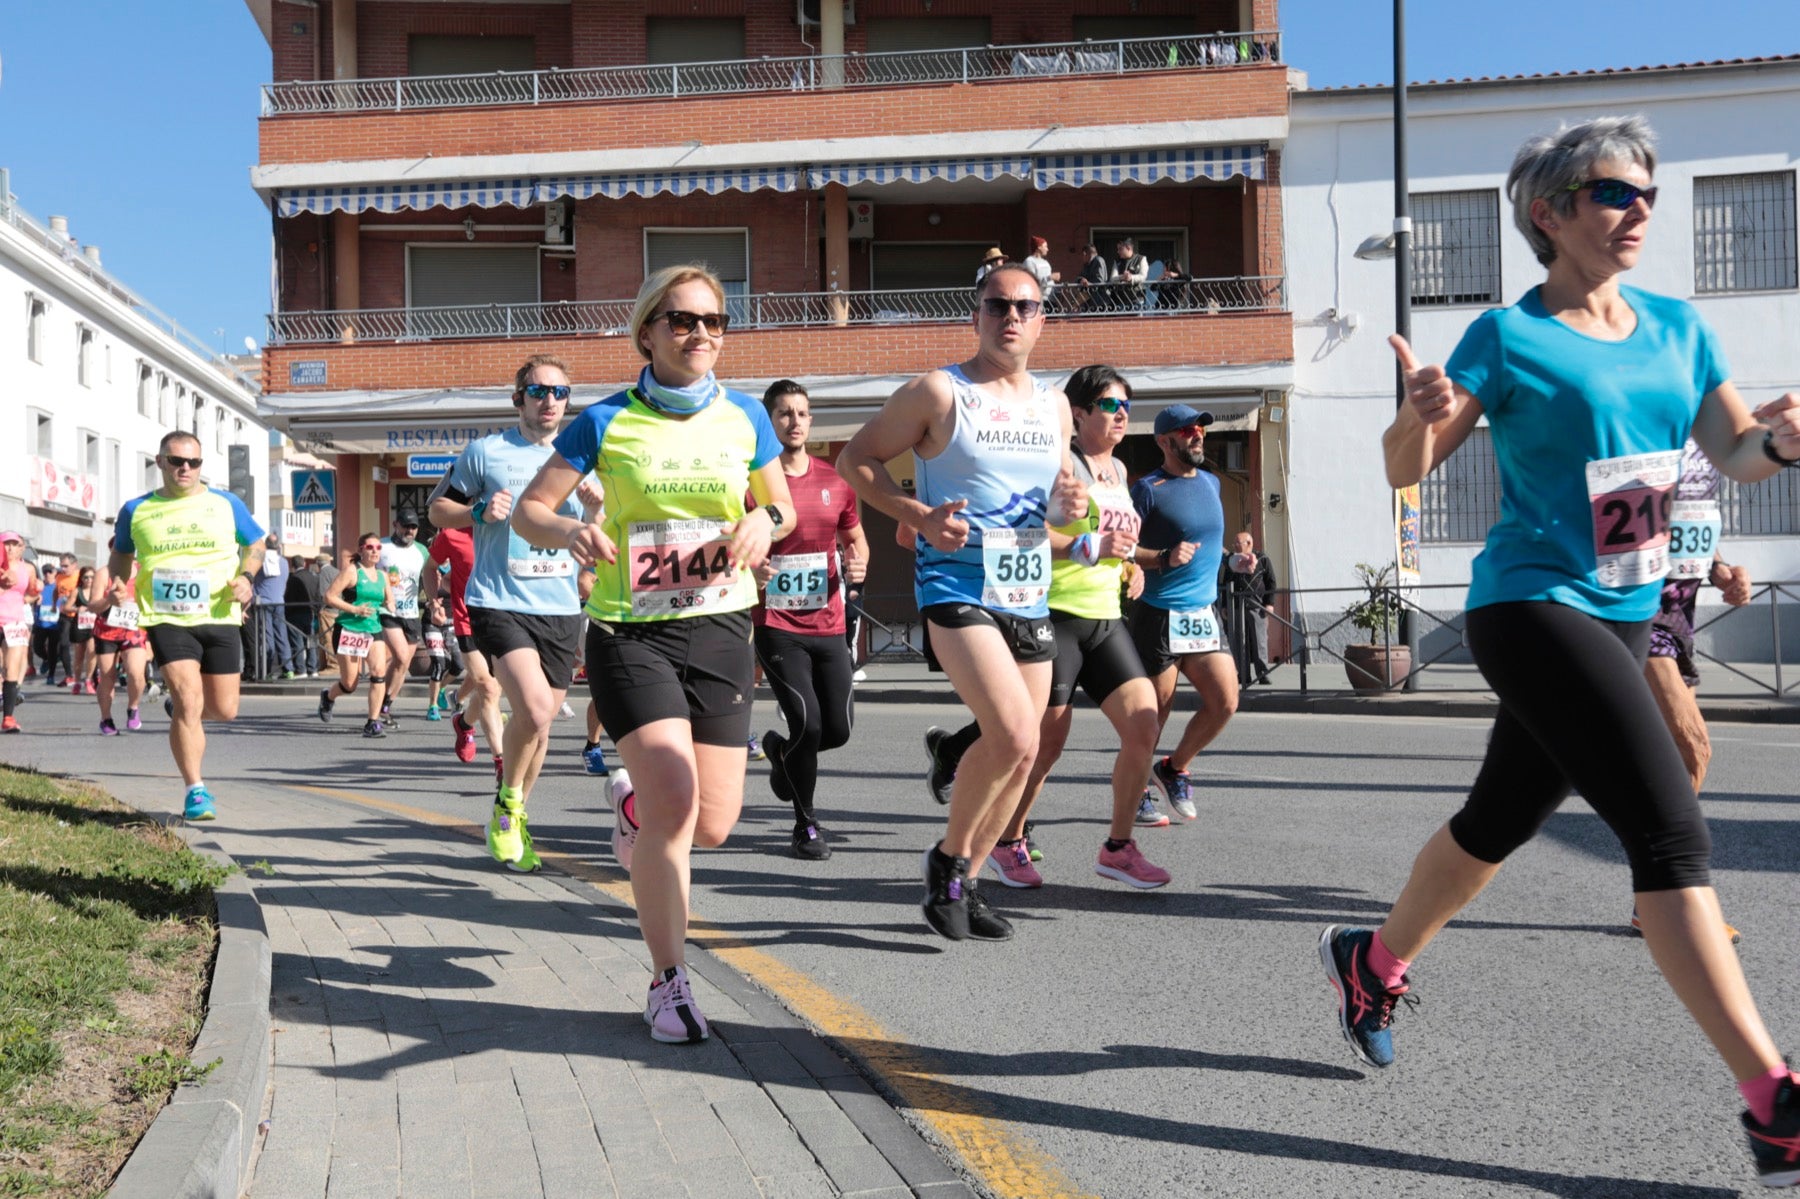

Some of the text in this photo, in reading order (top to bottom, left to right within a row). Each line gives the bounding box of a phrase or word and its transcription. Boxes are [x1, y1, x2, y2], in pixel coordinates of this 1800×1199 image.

[976, 429, 1055, 447] MARACENA
[411, 460, 451, 471] Granad
[644, 482, 727, 495] MARACENA
[1103, 509, 1139, 536] 2231
[1669, 525, 1712, 553] 839
[637, 545, 733, 586] 2144
[997, 553, 1042, 582] 583
[777, 570, 820, 592] 615
[162, 582, 201, 600] 750
[1179, 618, 1212, 636] 359
[341, 635, 369, 649] 2201
